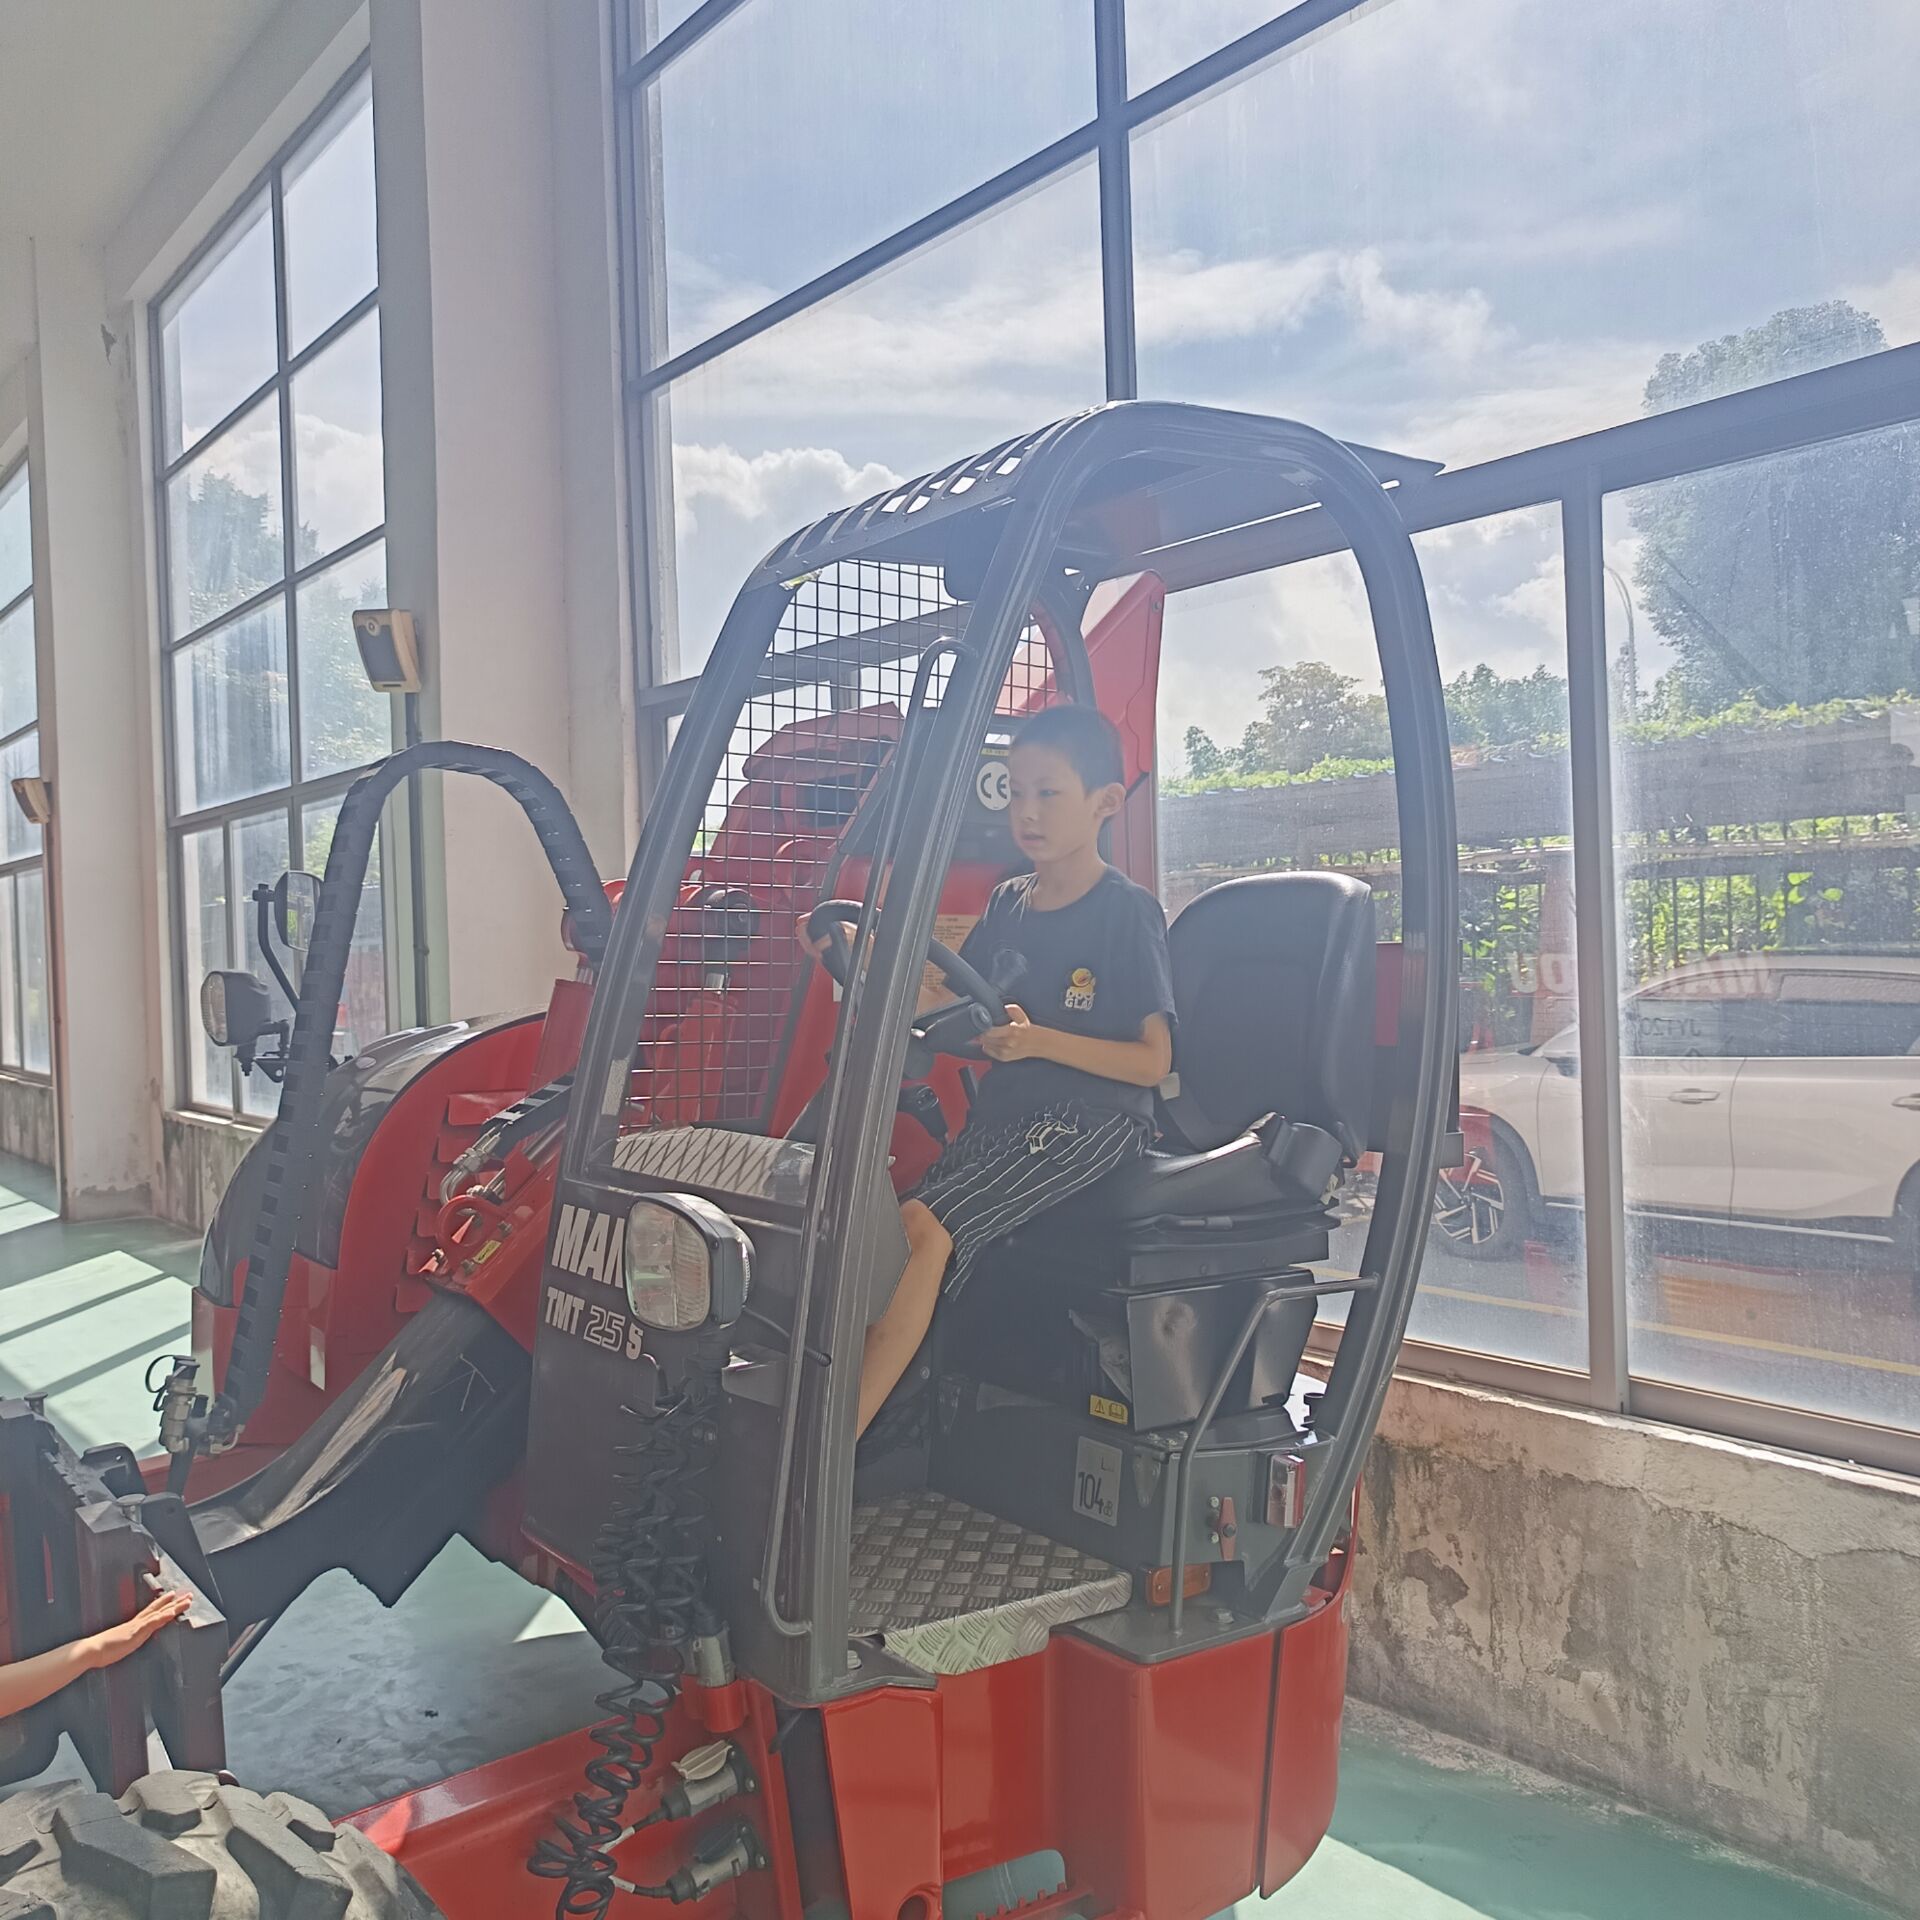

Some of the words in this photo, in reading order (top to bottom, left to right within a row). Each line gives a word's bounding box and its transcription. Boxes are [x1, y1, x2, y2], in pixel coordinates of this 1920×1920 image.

[545, 1286, 586, 1335] TMT
[583, 1304, 626, 1352] 25
[1078, 1471, 1104, 1515] 104
